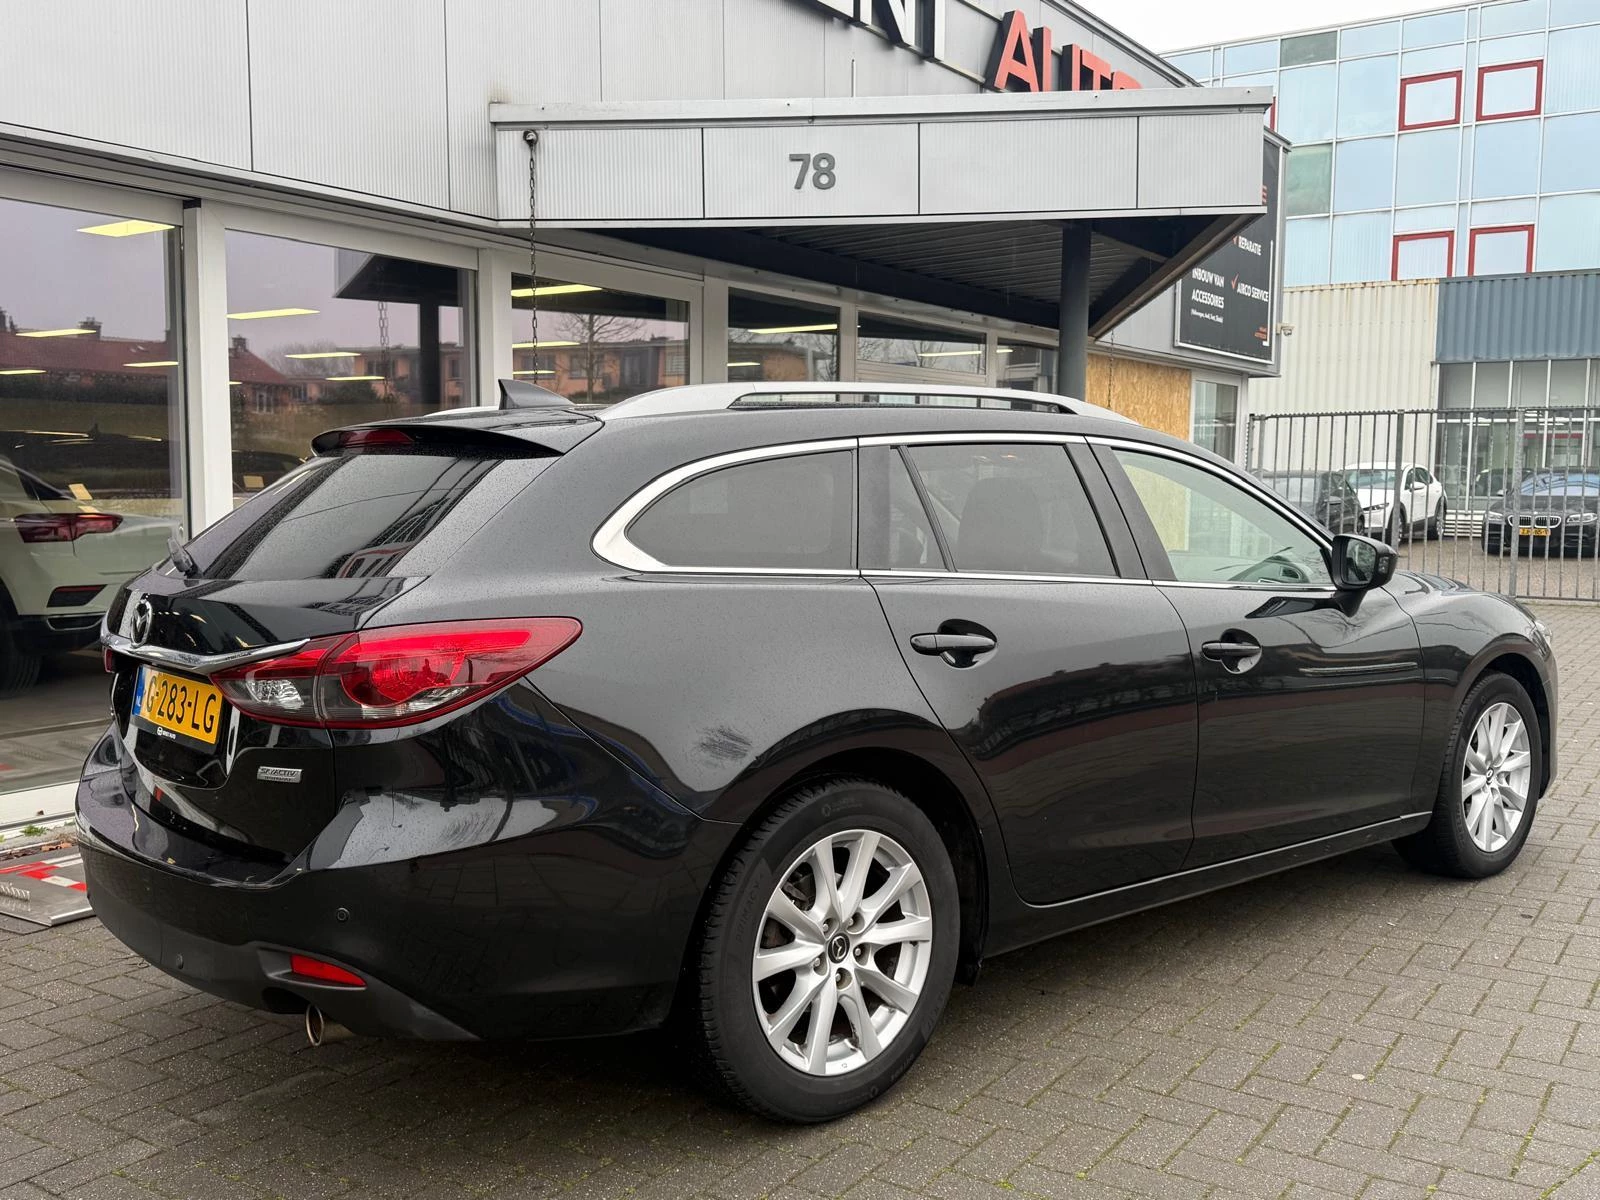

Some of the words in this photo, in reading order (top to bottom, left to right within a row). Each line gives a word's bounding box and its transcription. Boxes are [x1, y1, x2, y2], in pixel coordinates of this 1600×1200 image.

[993, 8, 1144, 93] AUT
[788, 152, 836, 190] 78
[1238, 235, 1261, 256] REPARATIE
[1192, 267, 1213, 284] INBOUW
[1214, 273, 1225, 288] VAN
[1192, 289, 1225, 309] ACCESSOIRES
[1237, 282, 1251, 297] AIRCO
[1251, 286, 1269, 302] SERVICE
[147, 675, 217, 734] G-283-LG
